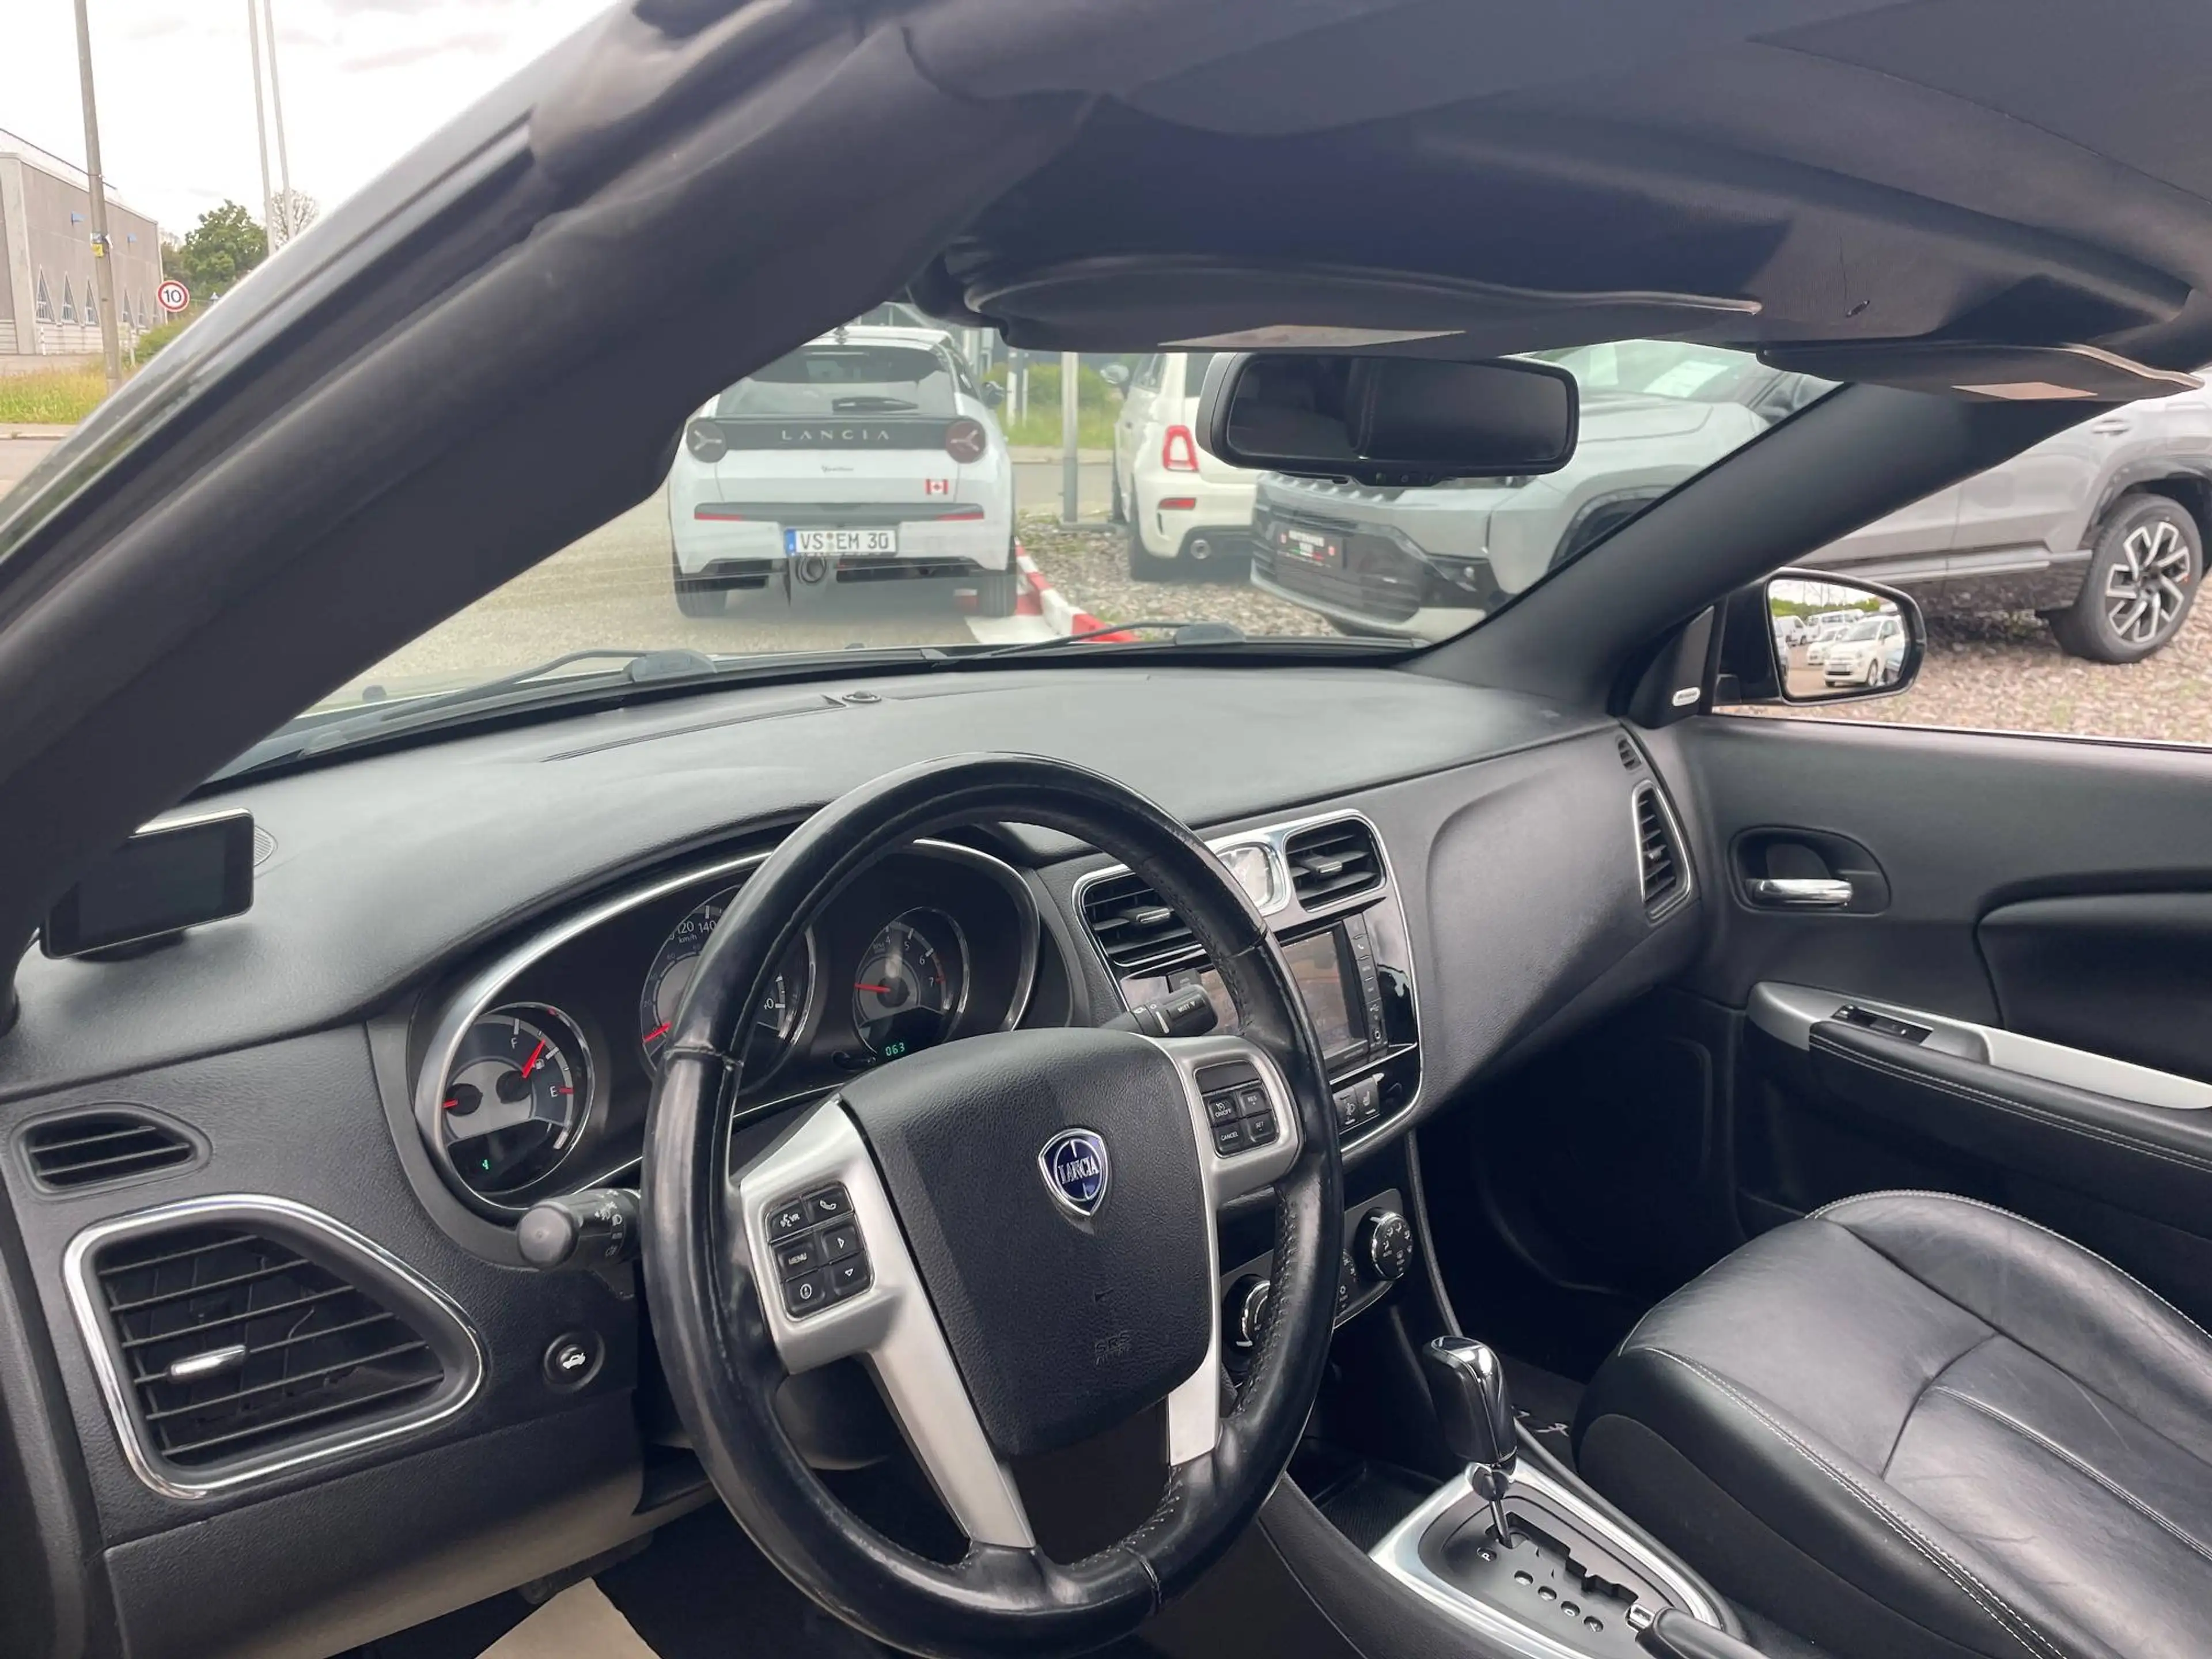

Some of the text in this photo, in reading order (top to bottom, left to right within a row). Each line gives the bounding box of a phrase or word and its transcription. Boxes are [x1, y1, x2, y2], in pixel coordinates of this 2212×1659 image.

[164, 289, 182, 304] 10
[781, 429, 890, 441] LANCIA
[800, 532, 889, 550] VS EM 30
[679, 933, 698, 944] km/h
[904, 941, 911, 950] 5
[919, 956, 926, 965] 6
[929, 977, 934, 987] 7
[511, 1037, 518, 1049] F
[885, 1041, 906, 1056] 063
[550, 1085, 558, 1097] E
[1215, 1108, 1231, 1118] ON/OFF
[1221, 1131, 1238, 1141] CANCEL
[1058, 1154, 1100, 1185] LANCIA
[788, 1252, 808, 1265] MENU
[1481, 1552, 1491, 1562] P
